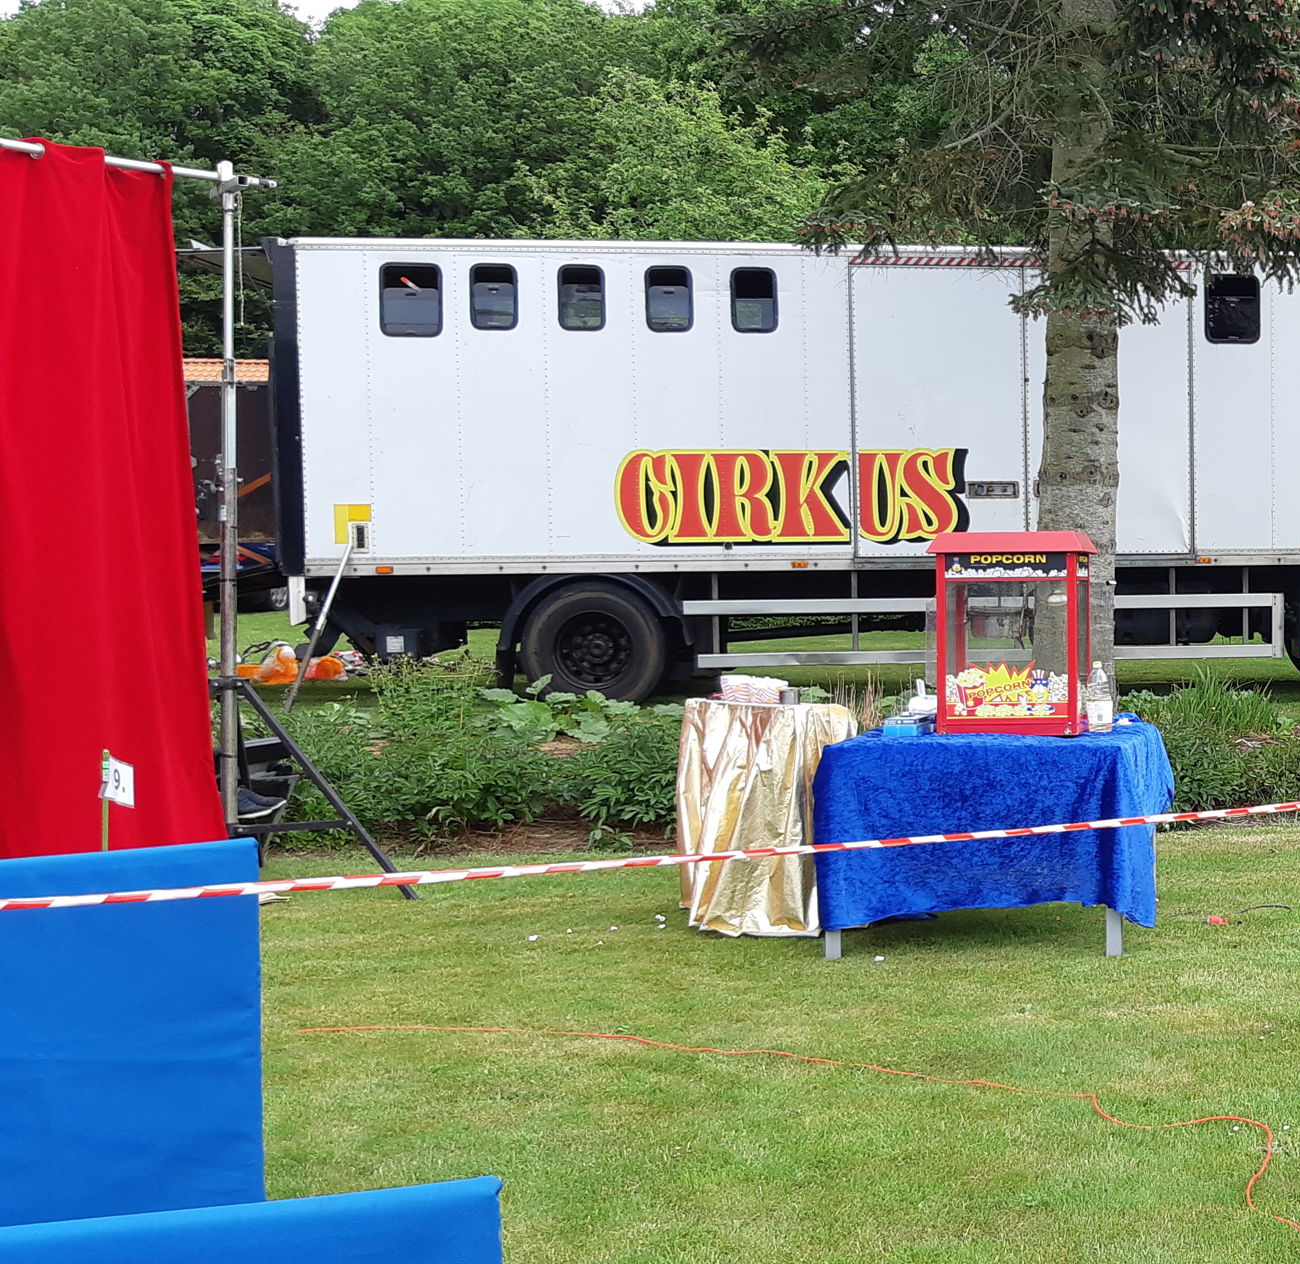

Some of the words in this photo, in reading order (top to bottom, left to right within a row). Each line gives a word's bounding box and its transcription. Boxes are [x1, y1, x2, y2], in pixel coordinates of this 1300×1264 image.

[615, 449, 969, 545] CIRKUS
[970, 554, 1047, 564] POPCORN
[968, 680, 1031, 700] POPCORN
